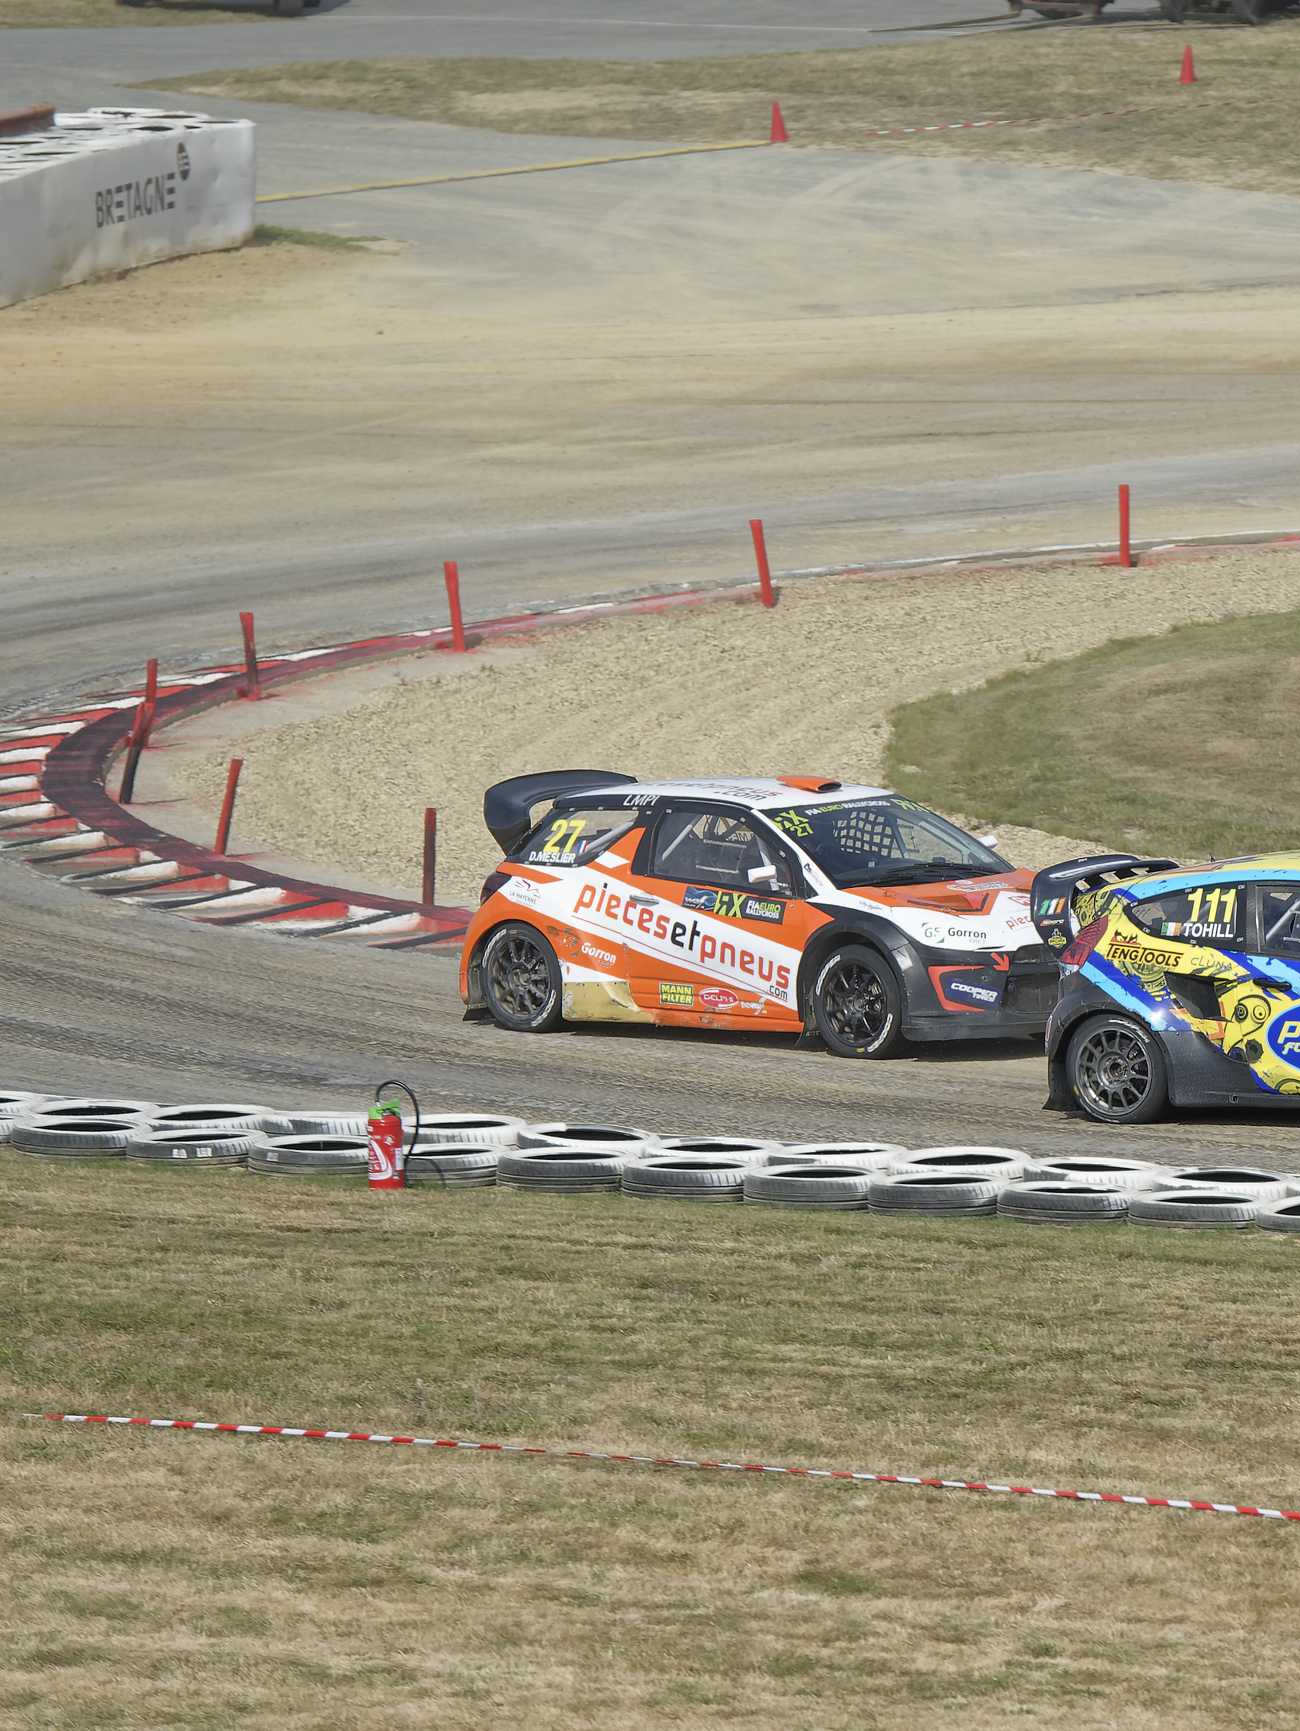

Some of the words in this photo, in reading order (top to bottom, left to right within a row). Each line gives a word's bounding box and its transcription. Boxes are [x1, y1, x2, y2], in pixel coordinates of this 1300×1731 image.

[95, 171, 177, 228] BRETAGNE
[543, 818, 587, 853] 27
[790, 822, 813, 837] 27
[1188, 888, 1236, 923] 111
[575, 882, 791, 990] piecesetpneus
[948, 927, 987, 940] Gorron
[1183, 922, 1234, 938] TOHILL
[581, 941, 617, 964] Gorron
[661, 983, 692, 994] MANN
[662, 992, 693, 1004] FILTER
